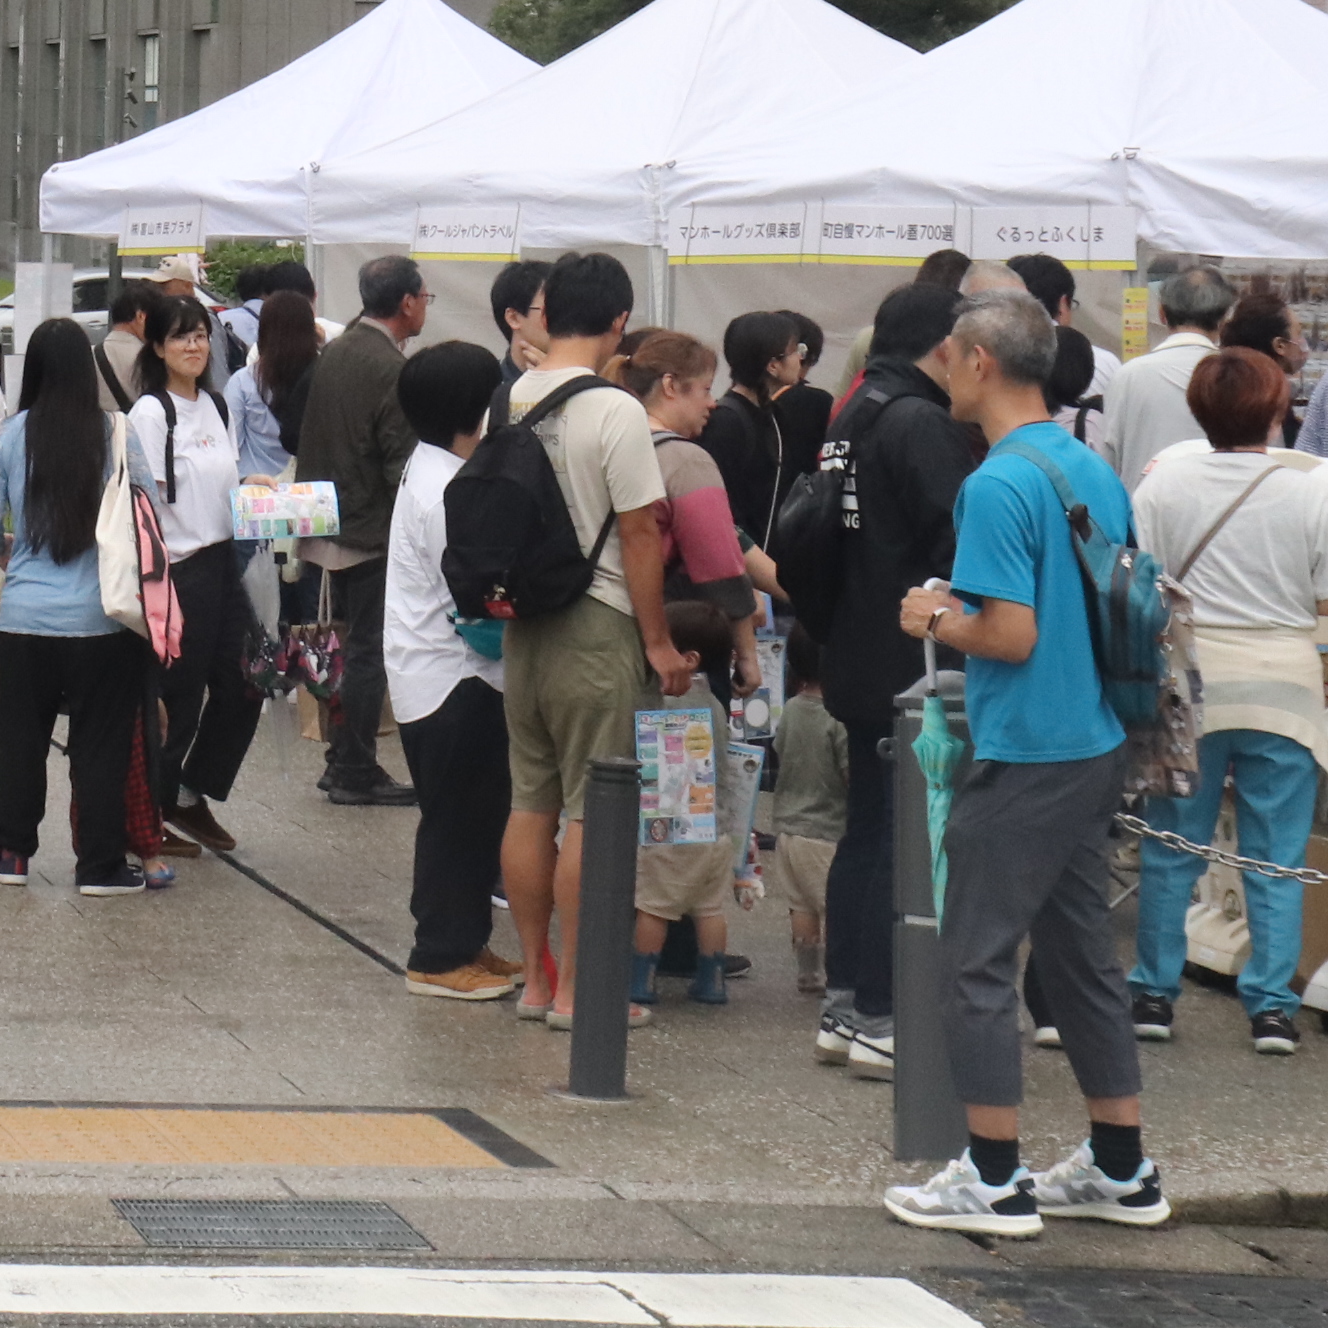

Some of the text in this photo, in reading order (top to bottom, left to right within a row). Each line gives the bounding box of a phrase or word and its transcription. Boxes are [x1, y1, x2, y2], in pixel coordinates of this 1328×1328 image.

[678, 222, 801, 240] マンホールグッズ倶楽部
[996, 226, 1104, 243] ぐるっとふくしま
